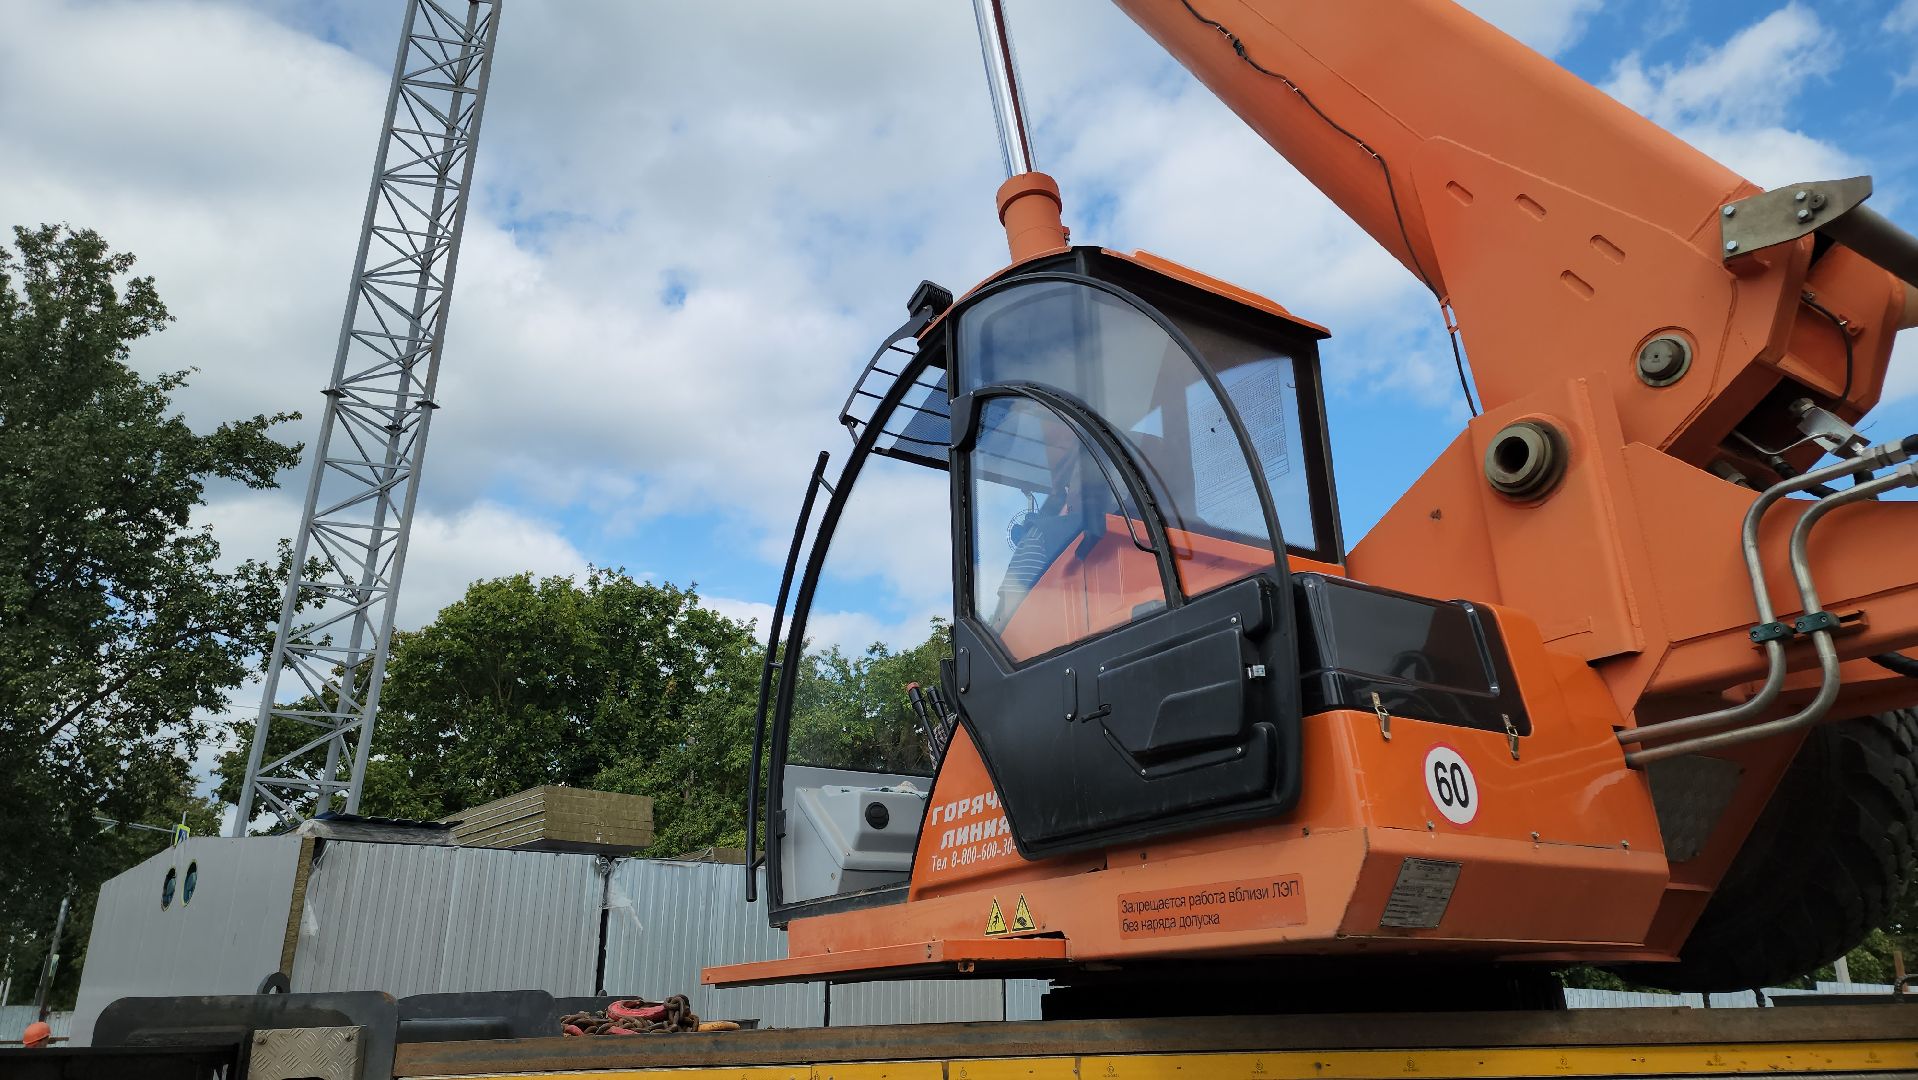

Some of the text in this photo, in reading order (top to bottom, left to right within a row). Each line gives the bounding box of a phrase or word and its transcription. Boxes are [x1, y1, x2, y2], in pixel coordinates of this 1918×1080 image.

[1434, 760, 1469, 808] 60
[940, 815, 1011, 850] ЛИНИЯ
[932, 855, 947, 872] Тел
[1121, 879, 1300, 915] Запрещается работа вблизи ЛЭП
[1122, 913, 1221, 934] без наряда допуска
